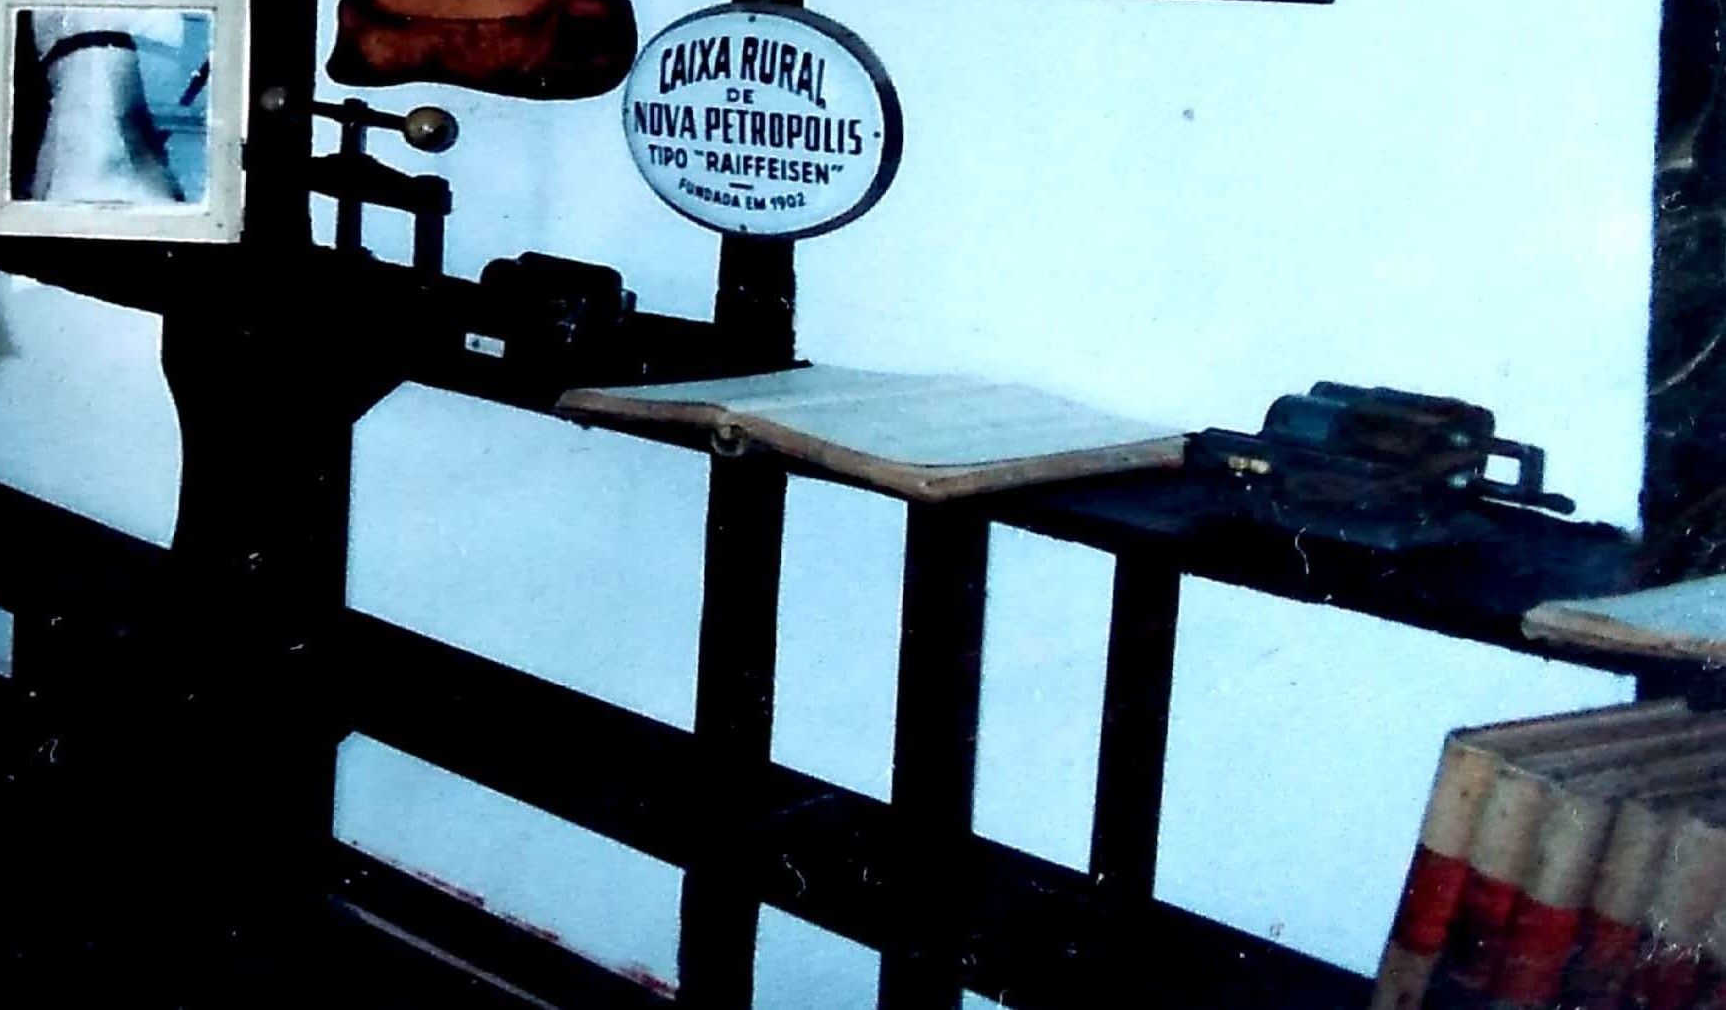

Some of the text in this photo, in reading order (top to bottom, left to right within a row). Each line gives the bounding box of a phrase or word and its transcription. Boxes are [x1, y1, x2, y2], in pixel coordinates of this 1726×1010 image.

[659, 36, 827, 110] CAIXA RURAL
[726, 88, 755, 104] DE
[634, 101, 863, 156] NOVA PETROPOLIS
[648, 144, 689, 169] TIPO
[678, 178, 807, 211] FUNDADA EM 1902
